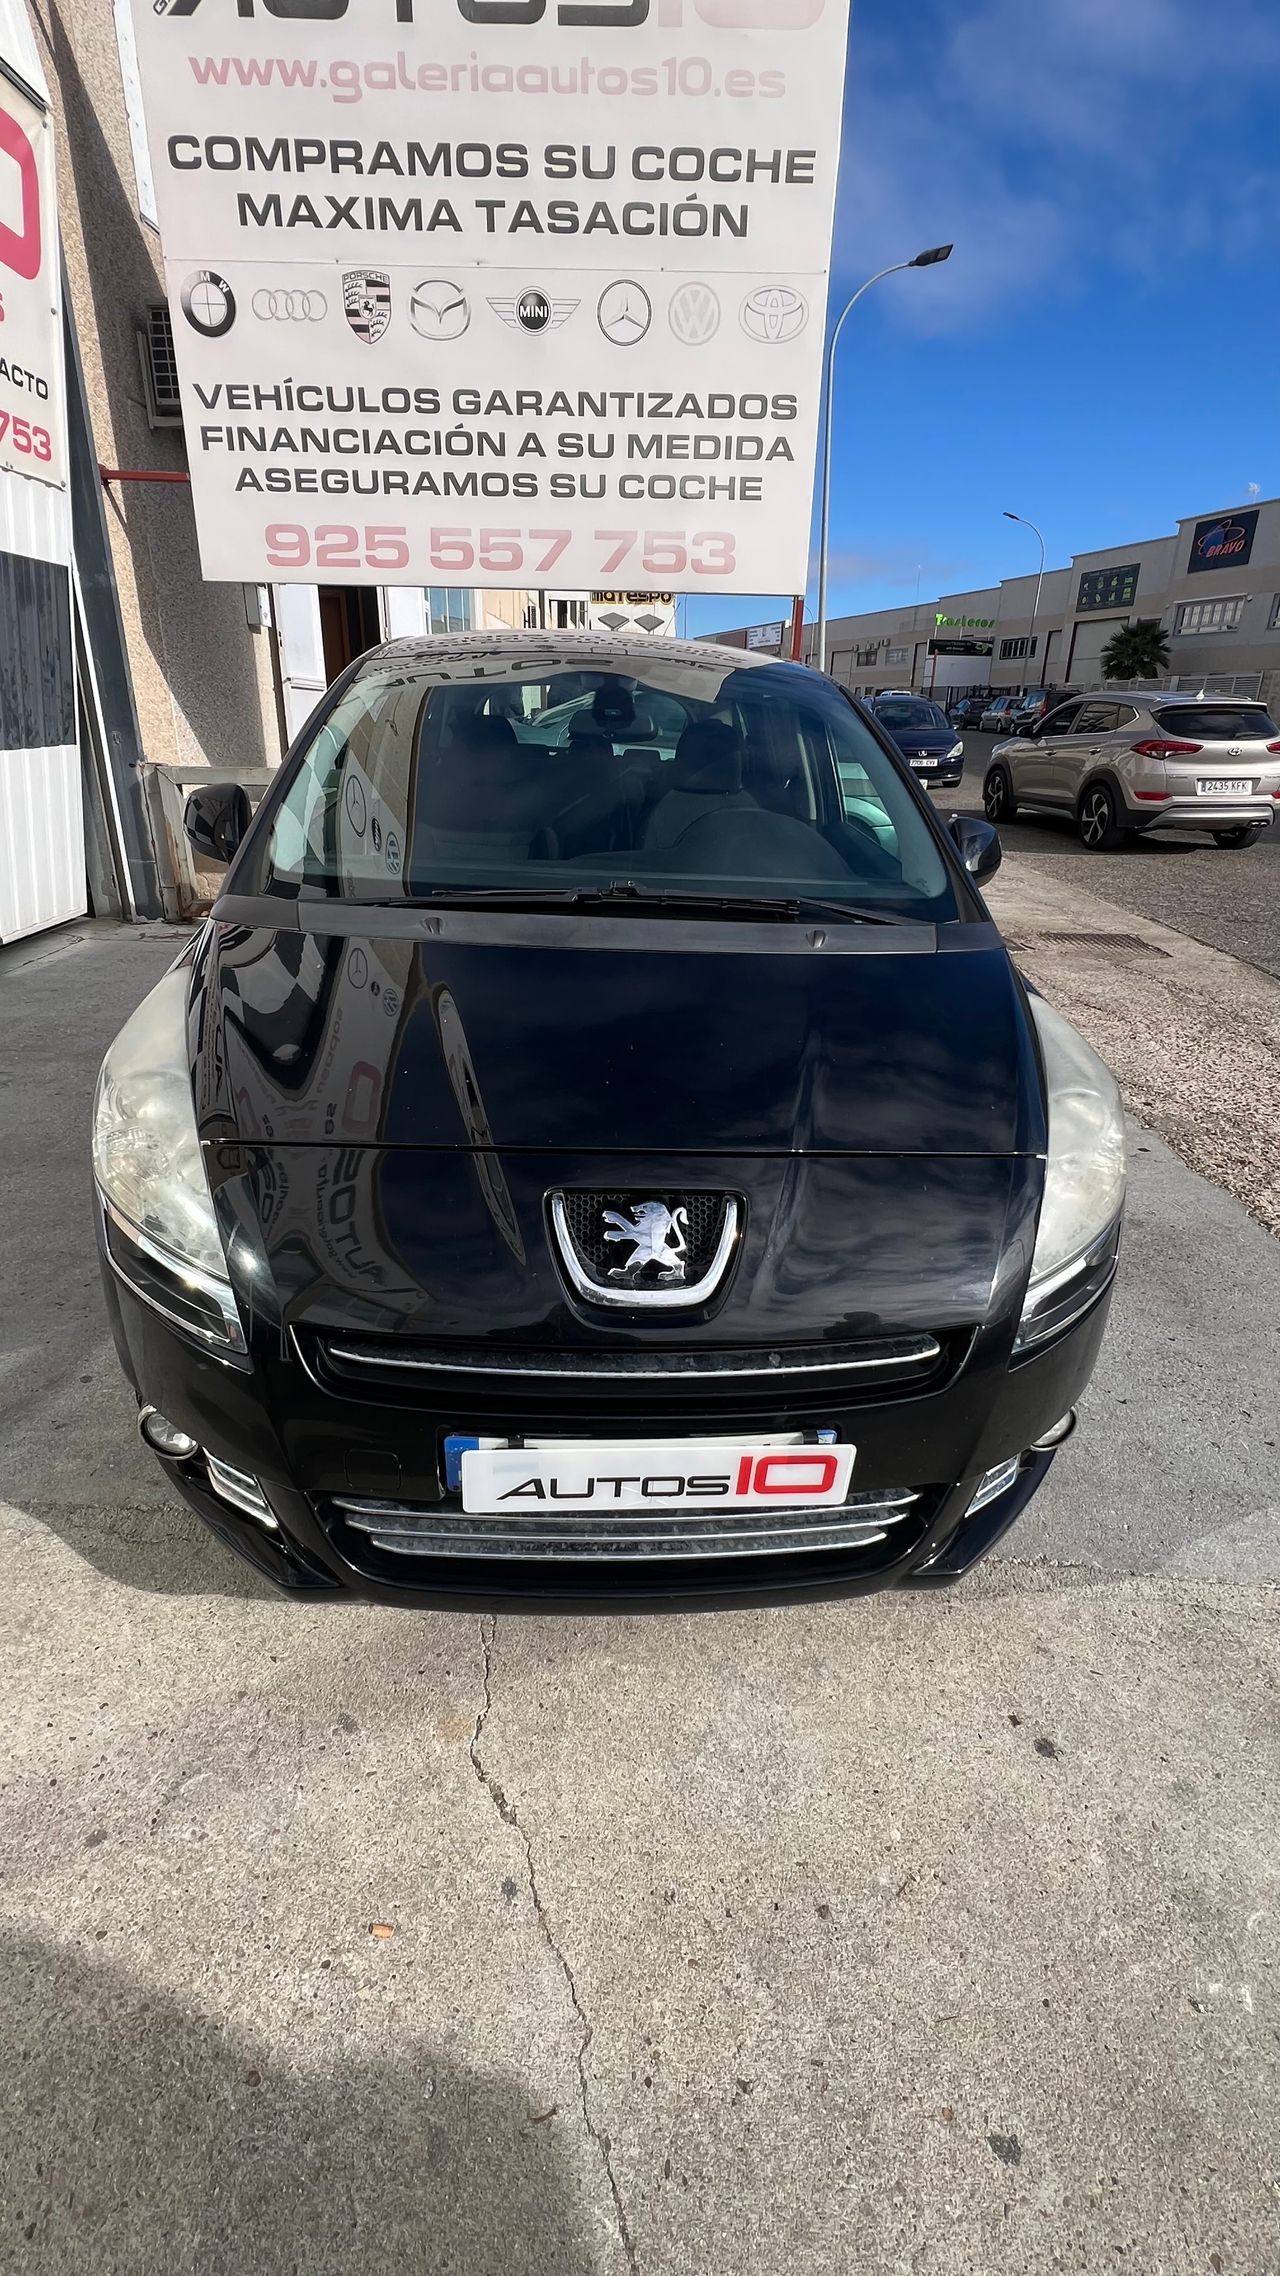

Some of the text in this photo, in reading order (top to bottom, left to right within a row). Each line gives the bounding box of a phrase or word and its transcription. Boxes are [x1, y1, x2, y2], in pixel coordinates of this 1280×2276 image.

[188, 51, 786, 103] www.galeriaautos10.es
[167, 135, 817, 184] COMPRAMOS SU COCHE
[236, 192, 748, 237] MAXIMA TASACIÓN
[342, 271, 390, 284] PORSCHE
[519, 304, 548, 319] MINI
[192, 376, 798, 420] VEHÍCULOS GARANTIZADOS
[200, 422, 795, 461] FINANCIACIÓN A SU MEDIDA
[235, 467, 763, 501] ASEGURAMOS SU COCHE
[265, 523, 736, 575] 925 557 753
[1205, 539, 1246, 558] BRAVO
[1207, 781, 1248, 791] 2435 KFK
